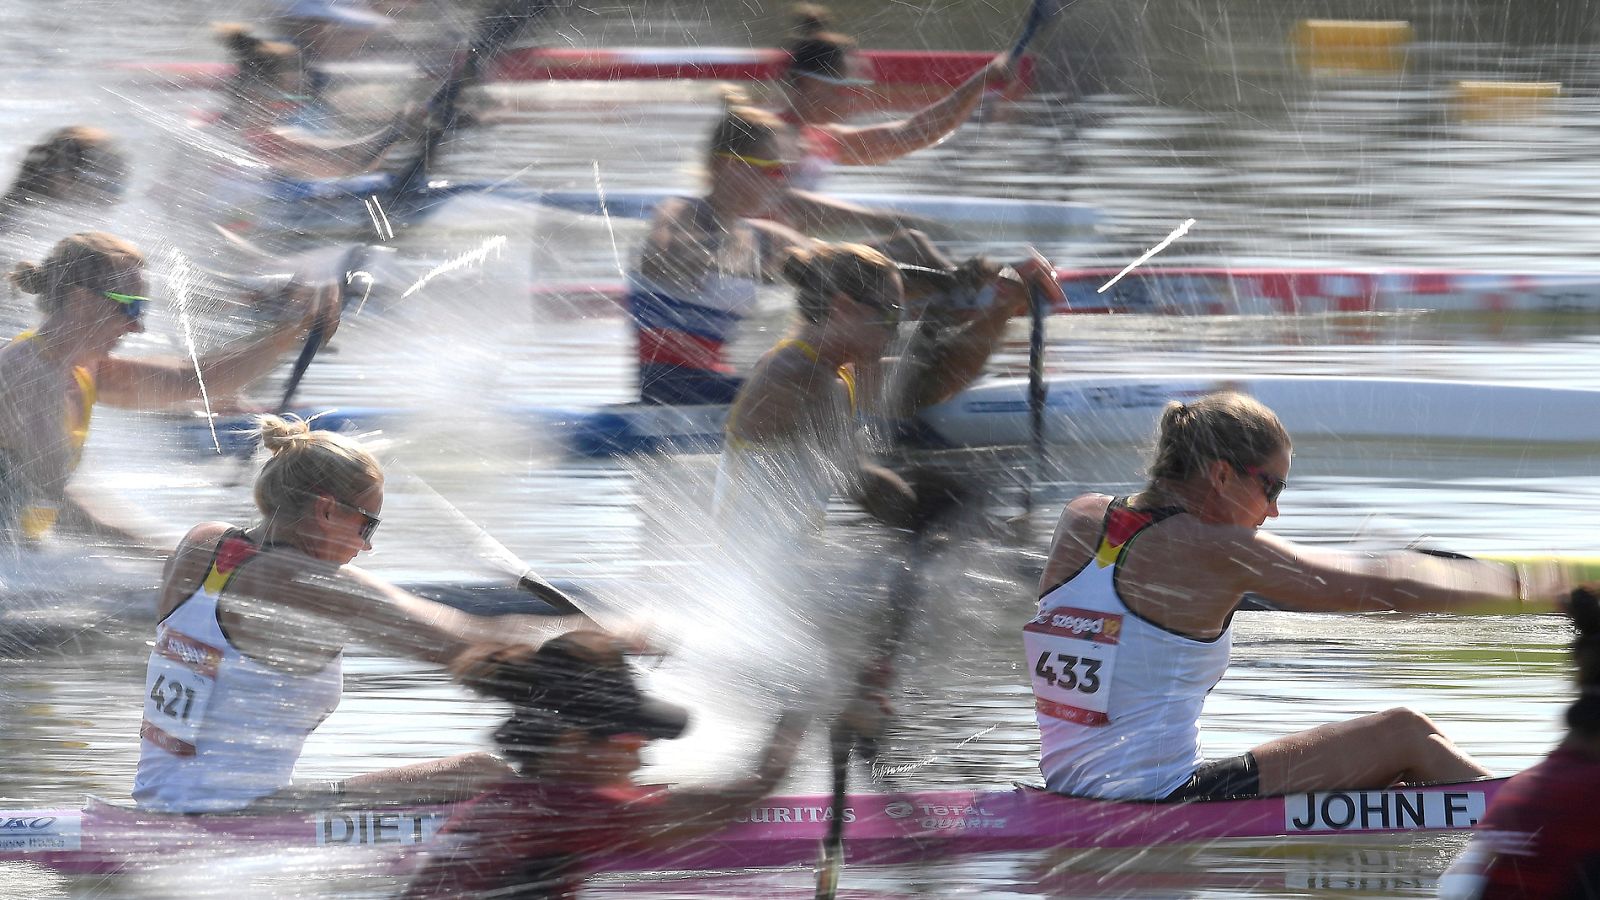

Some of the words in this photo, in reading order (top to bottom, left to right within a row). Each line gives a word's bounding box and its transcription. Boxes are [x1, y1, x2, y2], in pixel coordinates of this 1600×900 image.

[1035, 650, 1103, 695] 433
[150, 674, 195, 719] 421
[736, 806, 856, 823] URITAS
[919, 804, 995, 816] TOTAL
[1293, 791, 1426, 829] JOHN
[1444, 791, 1478, 828] F.
[324, 814, 444, 844] DIET
